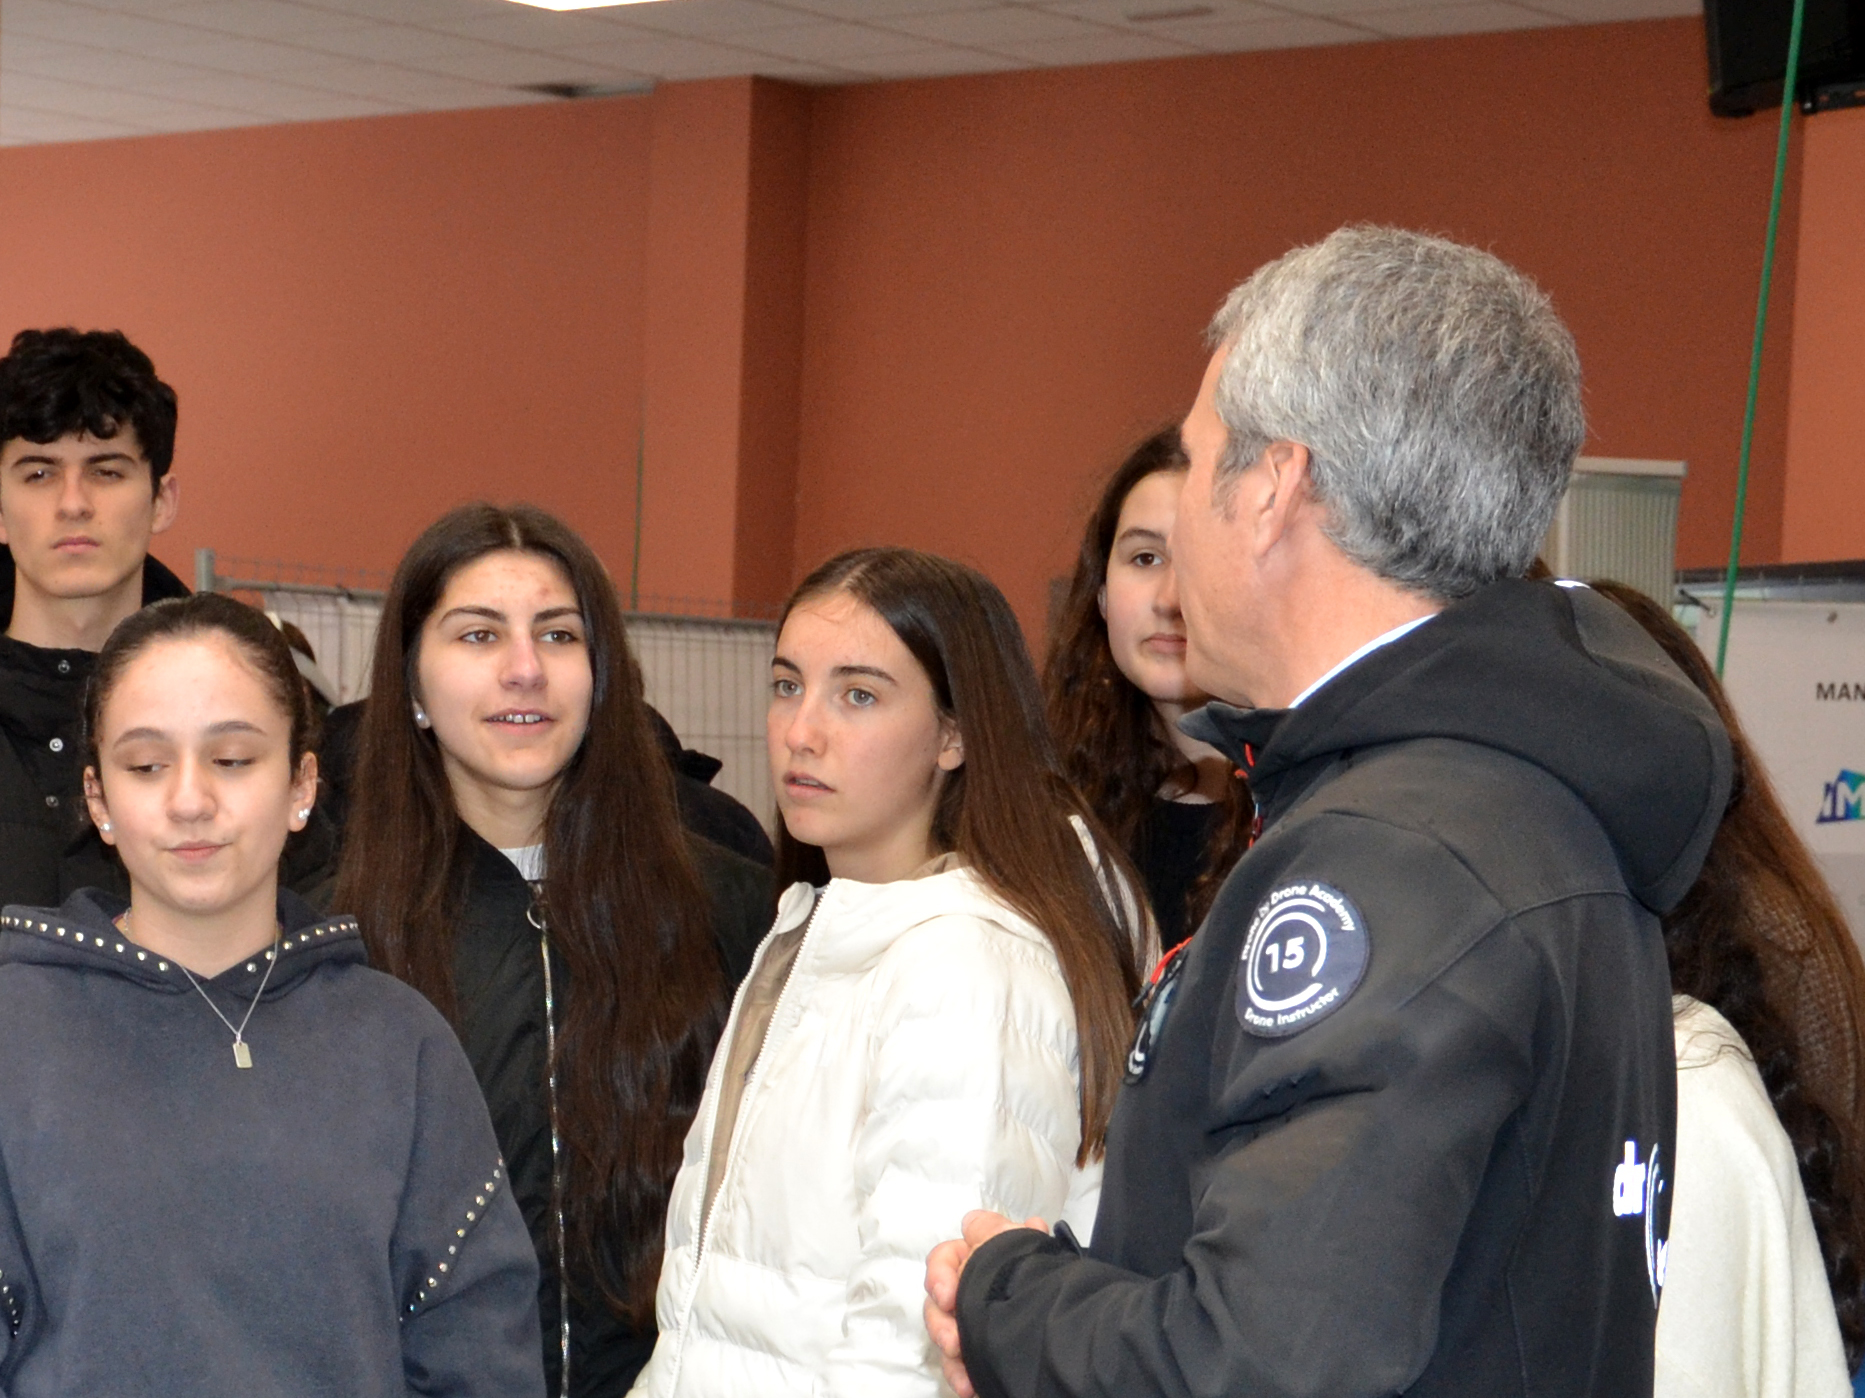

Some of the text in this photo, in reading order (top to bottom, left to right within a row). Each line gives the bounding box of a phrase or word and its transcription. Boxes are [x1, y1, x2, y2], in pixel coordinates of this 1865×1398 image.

[1270, 885, 1307, 904] Drone
[1309, 884, 1355, 931] Academy
[1265, 936, 1305, 974] 15
[1244, 987, 1340, 1027] Drone Instructor
